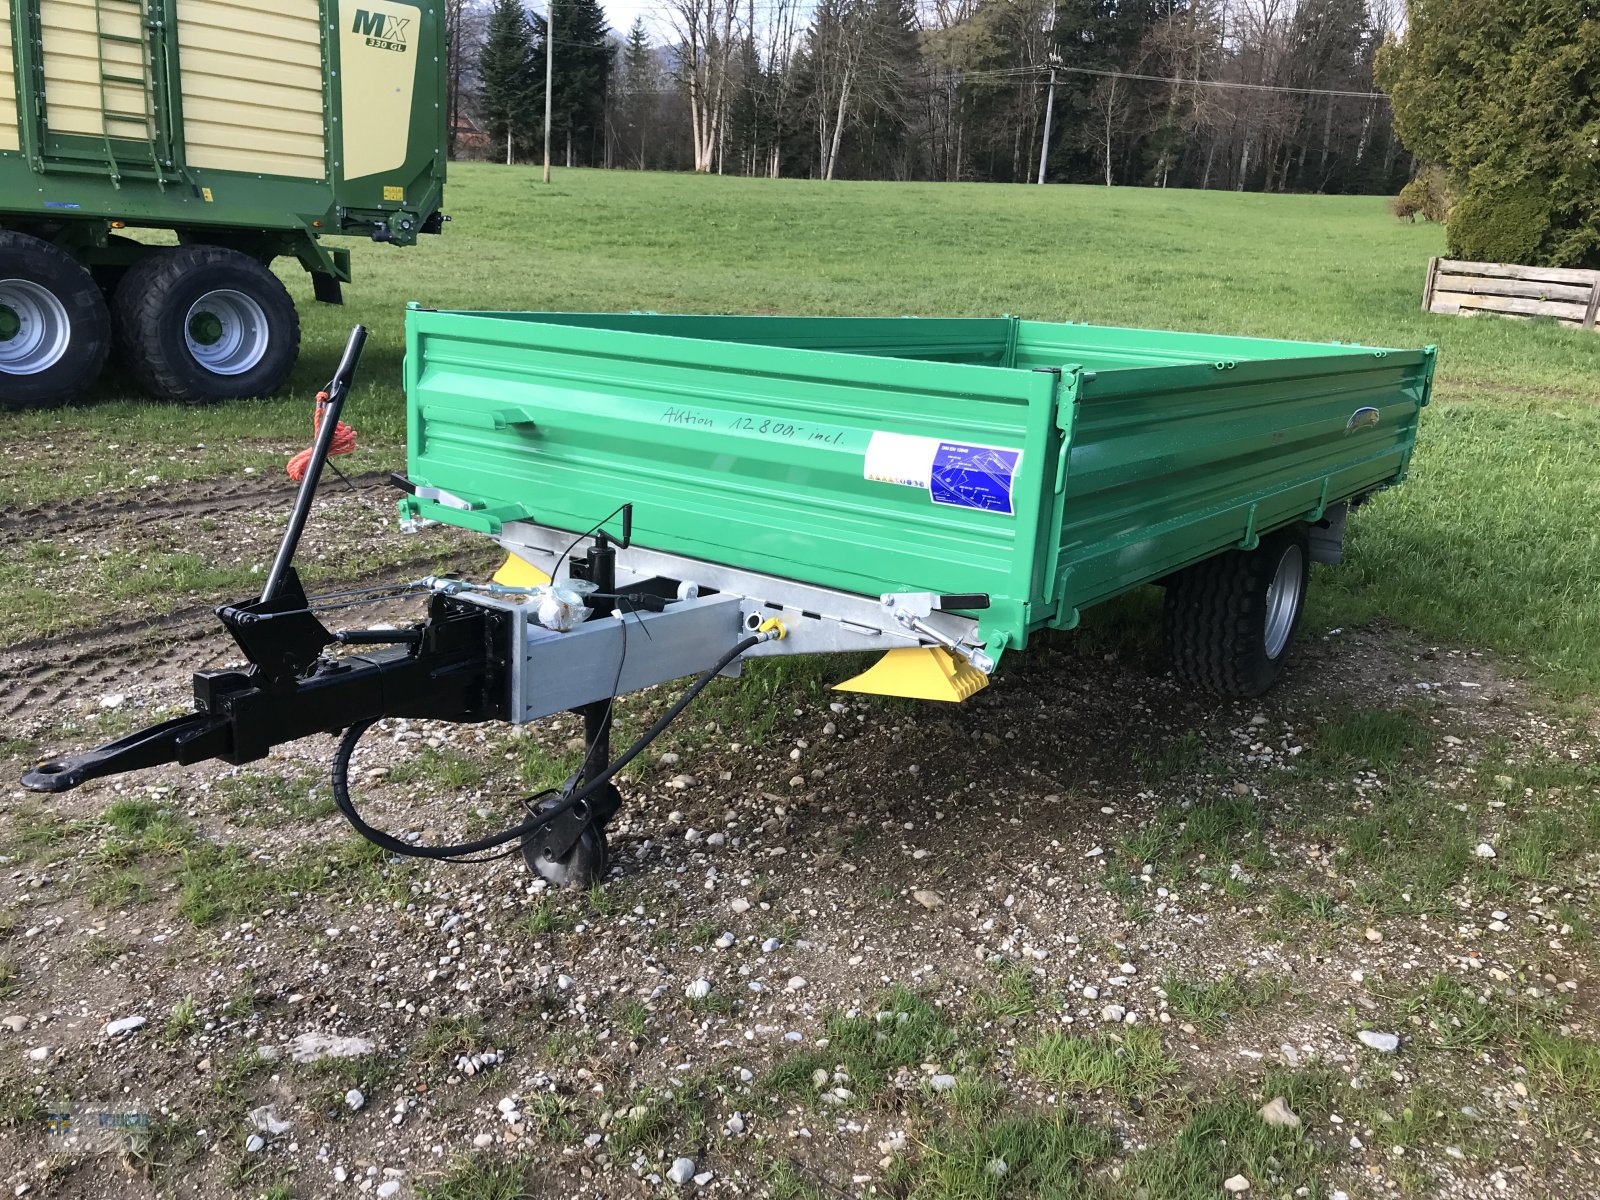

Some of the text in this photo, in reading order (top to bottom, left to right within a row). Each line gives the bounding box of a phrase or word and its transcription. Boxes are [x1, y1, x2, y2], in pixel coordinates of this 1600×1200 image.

[352, 9, 410, 43] MX
[368, 39, 404, 52] 330 GL
